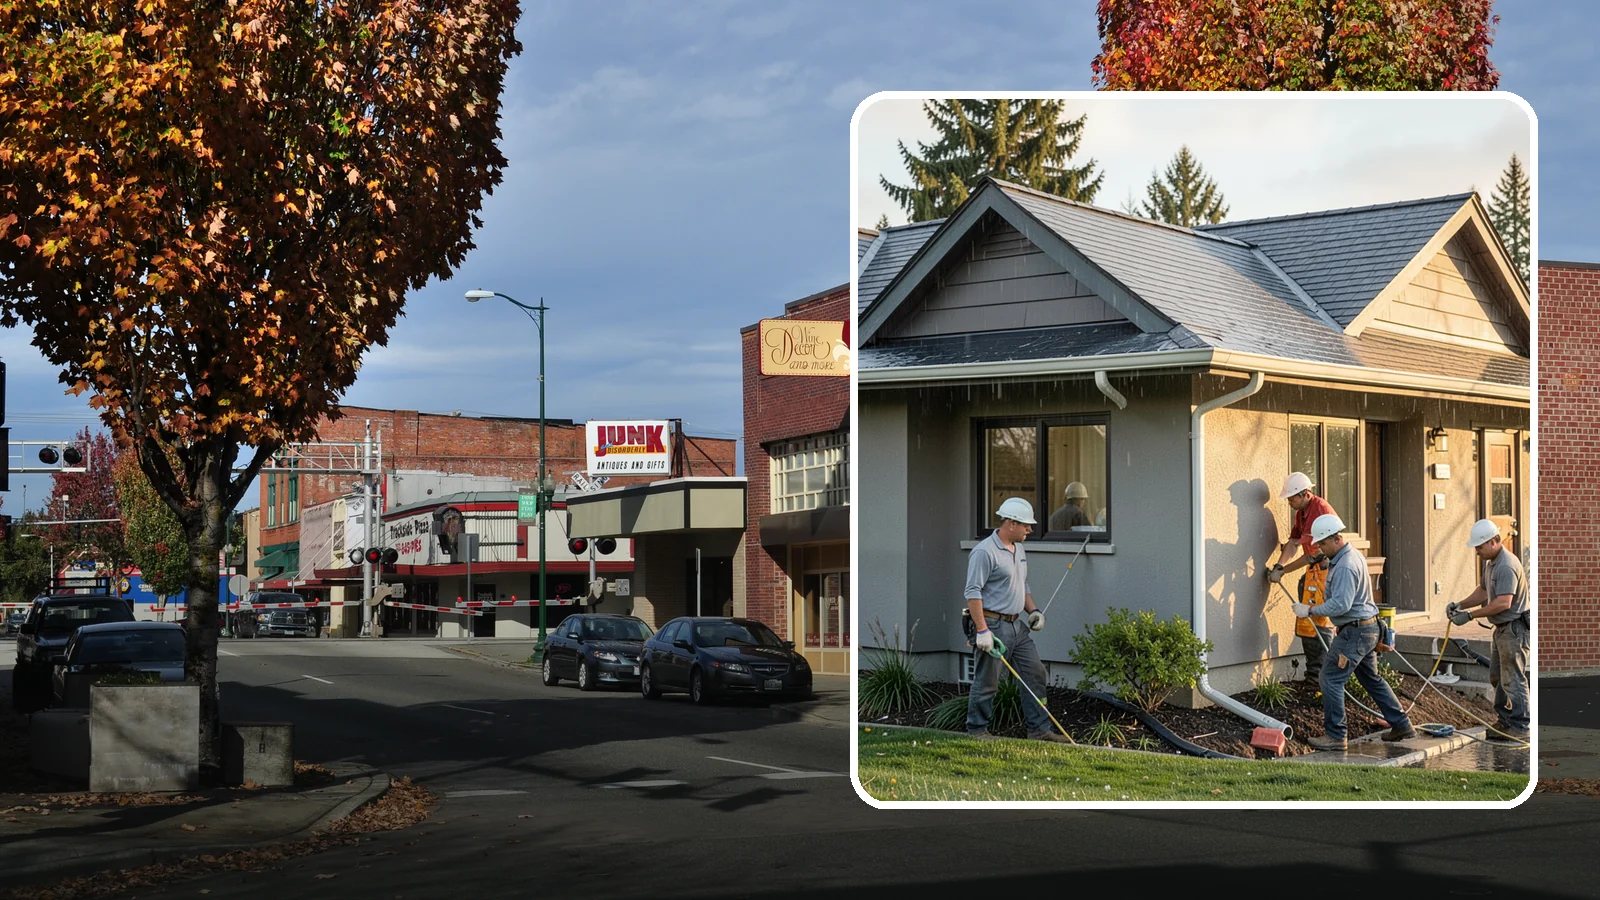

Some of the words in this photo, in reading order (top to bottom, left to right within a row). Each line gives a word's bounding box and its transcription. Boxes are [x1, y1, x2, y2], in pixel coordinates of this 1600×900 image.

[596, 425, 664, 457] JUNK
[607, 446, 646, 454] DISORDERLY
[597, 461, 628, 470] ANTIQUES
[631, 461, 644, 470] AND
[647, 460, 665, 470] GIFTS
[390, 521, 413, 540] Trackside
[414, 519, 429, 535] Pizza
